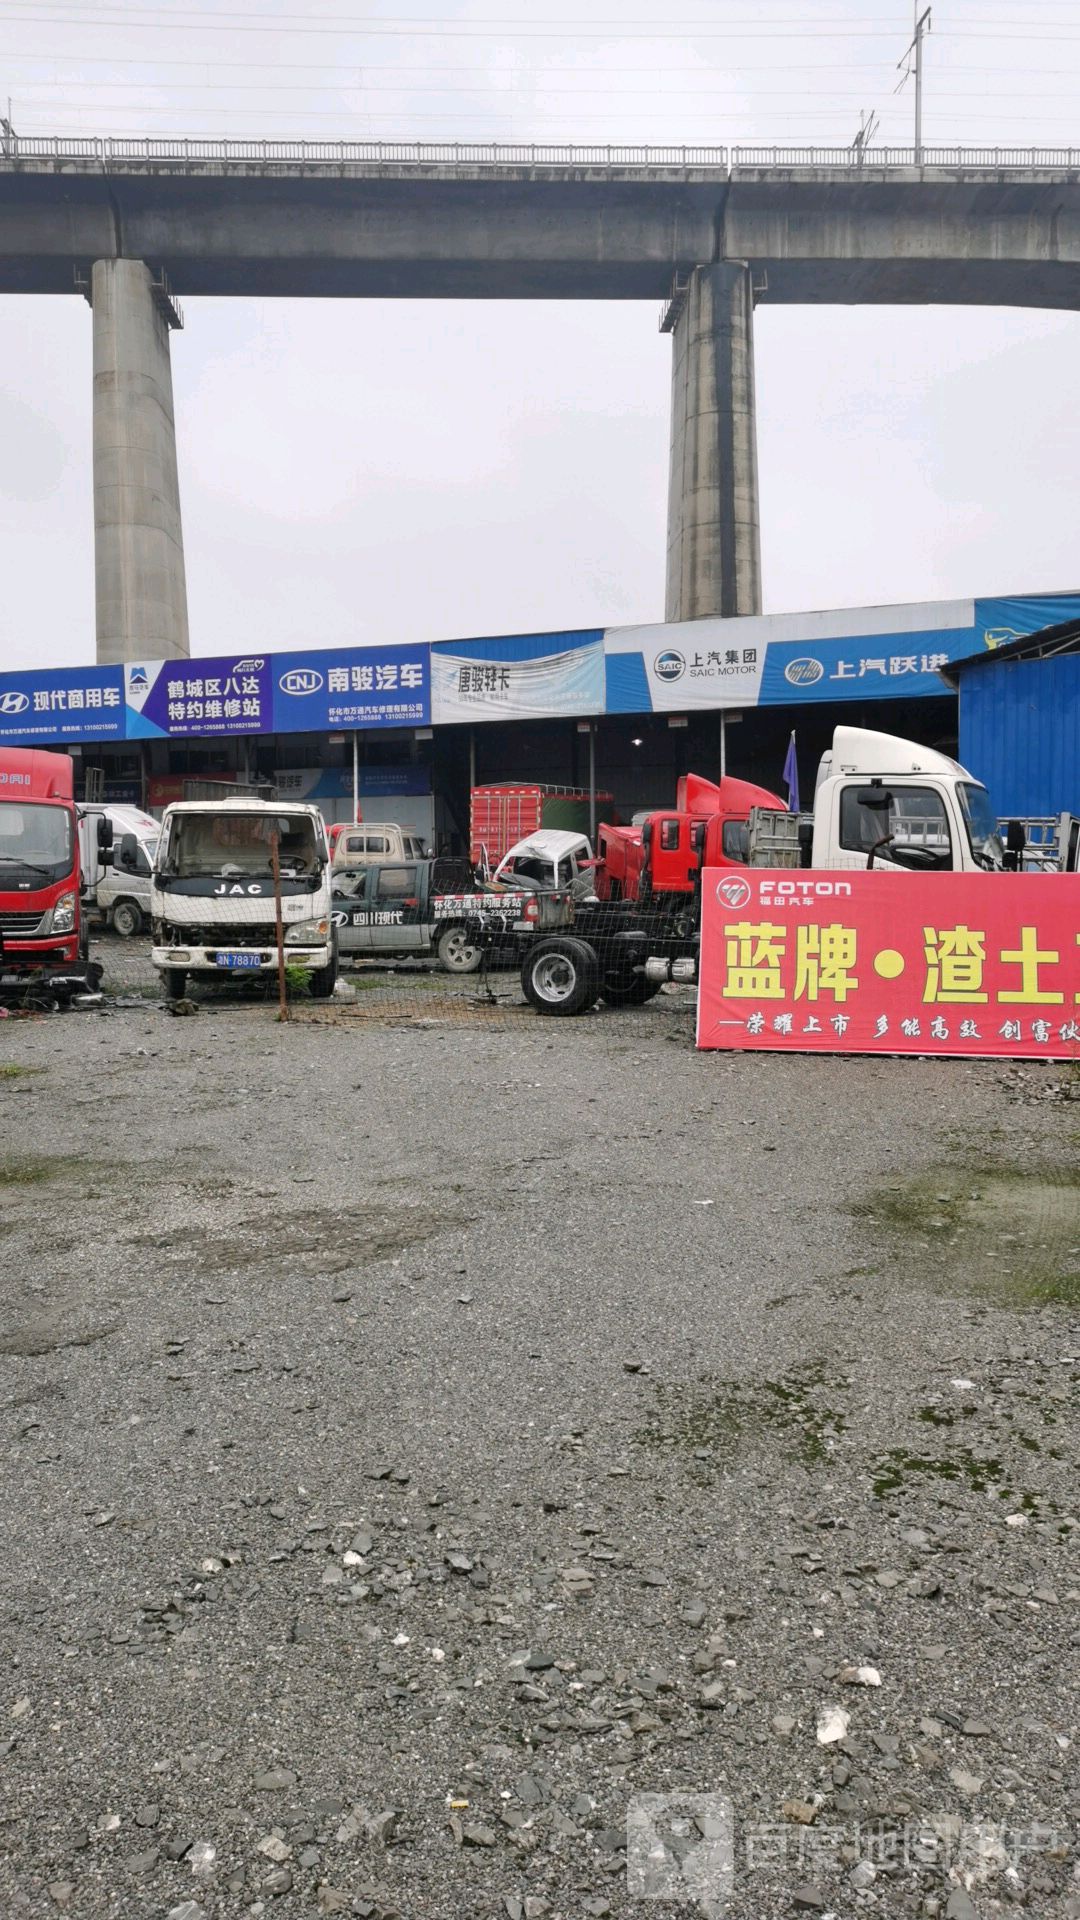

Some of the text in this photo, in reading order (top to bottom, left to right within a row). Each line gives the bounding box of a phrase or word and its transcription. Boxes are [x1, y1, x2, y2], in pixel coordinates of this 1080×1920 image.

[657, 663, 682, 671] SAIC
[689, 648, 757, 667] 上汽集团
[829, 653, 949, 679] 上汽跃进
[327, 663, 423, 692] 南骏汽车
[458, 665, 511, 692] 唐骏轻卡
[690, 666, 756, 677] SAIC MOTOR
[167, 675, 260, 699] 鹤城区八达
[286, 674, 317, 690] CNJ
[33, 688, 120, 711] 现代商用车
[168, 698, 260, 720] 特约维修站
[214, 884, 262, 894] JAC
[759, 881, 852, 896] FOTON
[434, 897, 522, 910] 怀化万通特约服务站
[760, 896, 814, 906] 福田汽车
[353, 911, 404, 925] 四川现代
[722, 921, 1080, 1004] 蓝牌●渣土
[872, 1012, 983, 1041] 多能高效
